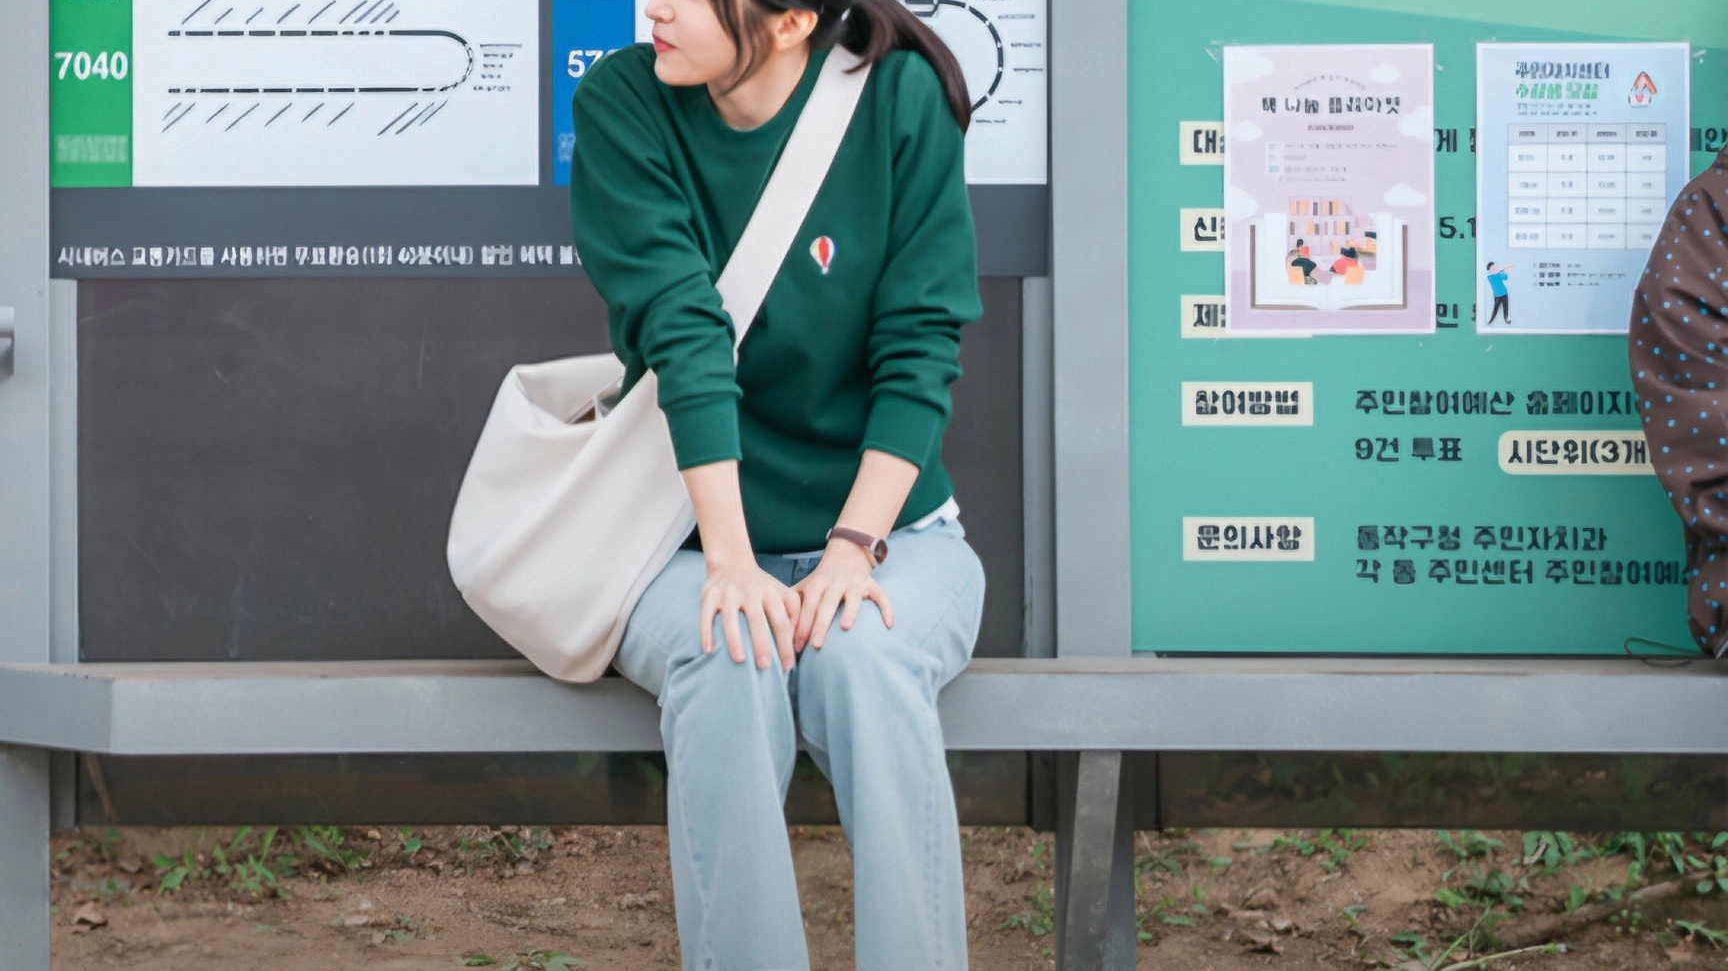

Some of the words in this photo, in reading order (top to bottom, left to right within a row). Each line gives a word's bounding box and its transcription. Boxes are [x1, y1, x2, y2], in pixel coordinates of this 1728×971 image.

[54, 51, 128, 80] 7040
[567, 49, 617, 78] 57
[1197, 525, 1302, 550] 문의사항
[1428, 559, 1533, 584] 주민센터
